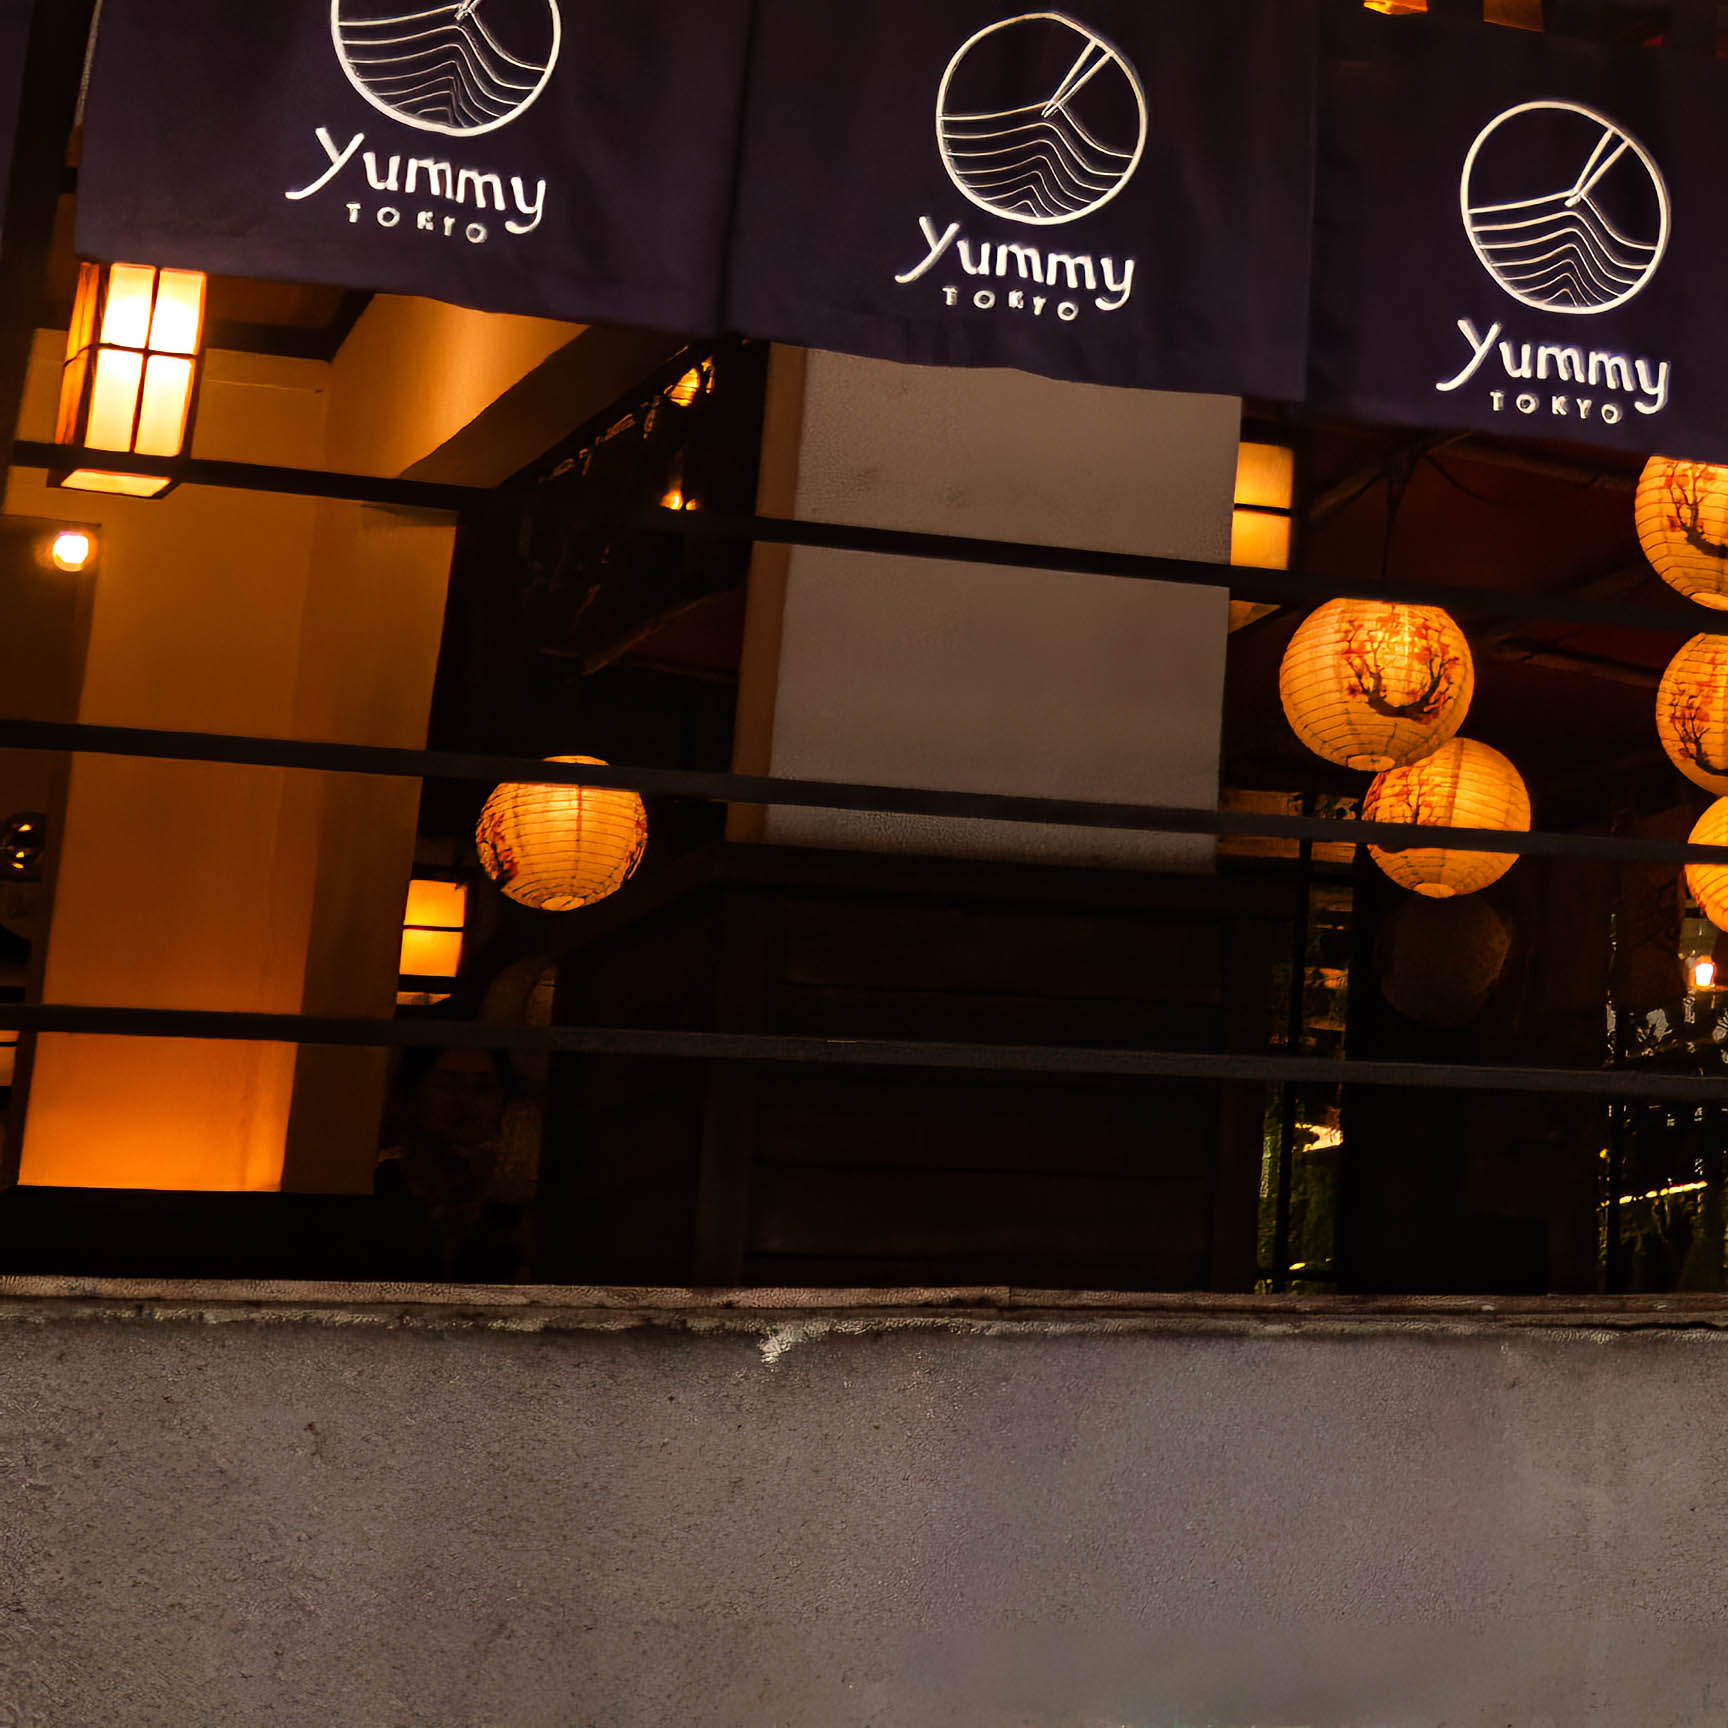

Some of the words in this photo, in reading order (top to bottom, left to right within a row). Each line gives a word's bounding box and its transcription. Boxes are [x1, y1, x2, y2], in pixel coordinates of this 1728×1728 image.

[345, 201, 488, 244] TOKYO
[941, 285, 1079, 321] TOKYO
[1489, 390, 1624, 425] TOKYO
